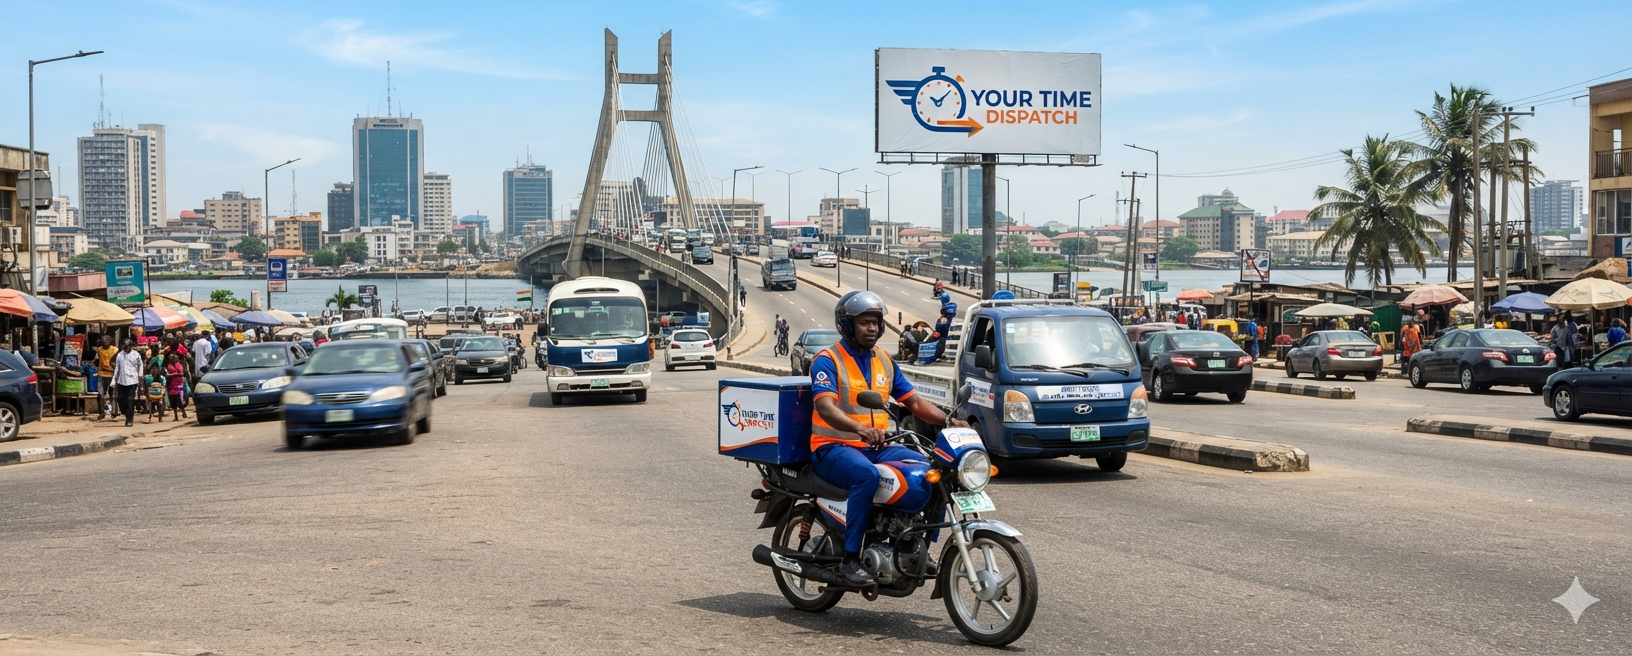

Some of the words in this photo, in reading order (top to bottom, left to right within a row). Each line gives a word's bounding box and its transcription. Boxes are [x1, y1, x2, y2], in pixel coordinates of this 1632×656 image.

[971, 89, 1033, 108] YOUR
[1039, 90, 1092, 108] TIME
[986, 109, 1078, 125] DISPATCH
